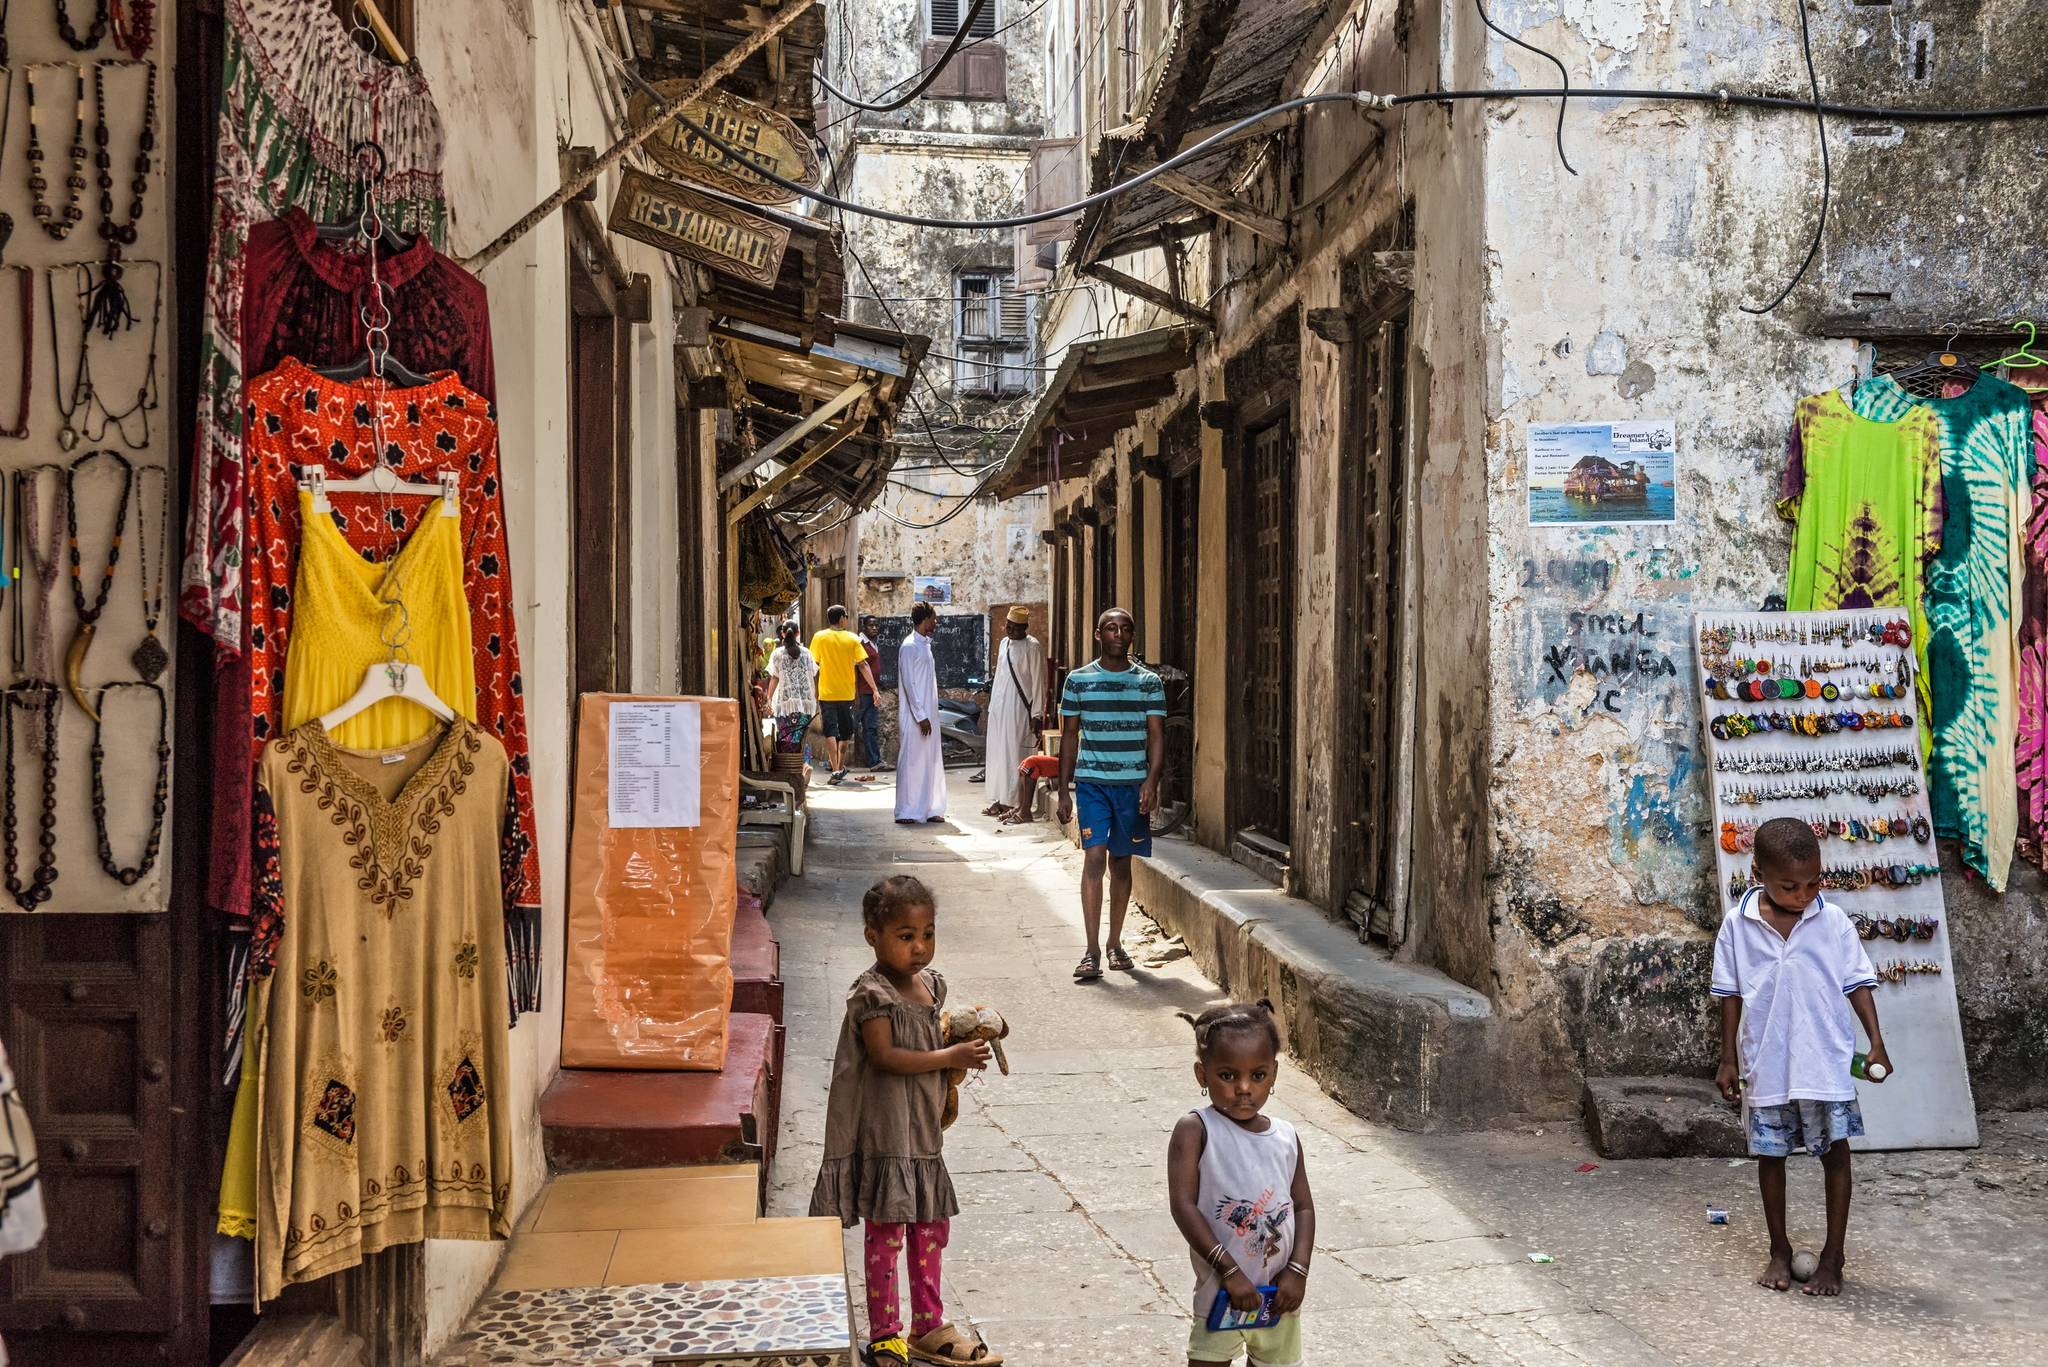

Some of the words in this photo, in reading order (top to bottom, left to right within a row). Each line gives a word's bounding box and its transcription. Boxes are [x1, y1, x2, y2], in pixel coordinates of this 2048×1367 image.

[704, 107, 760, 149] THE
[630, 192, 770, 268] RESTAURANT
[1613, 431, 1650, 439] Dreamer's
